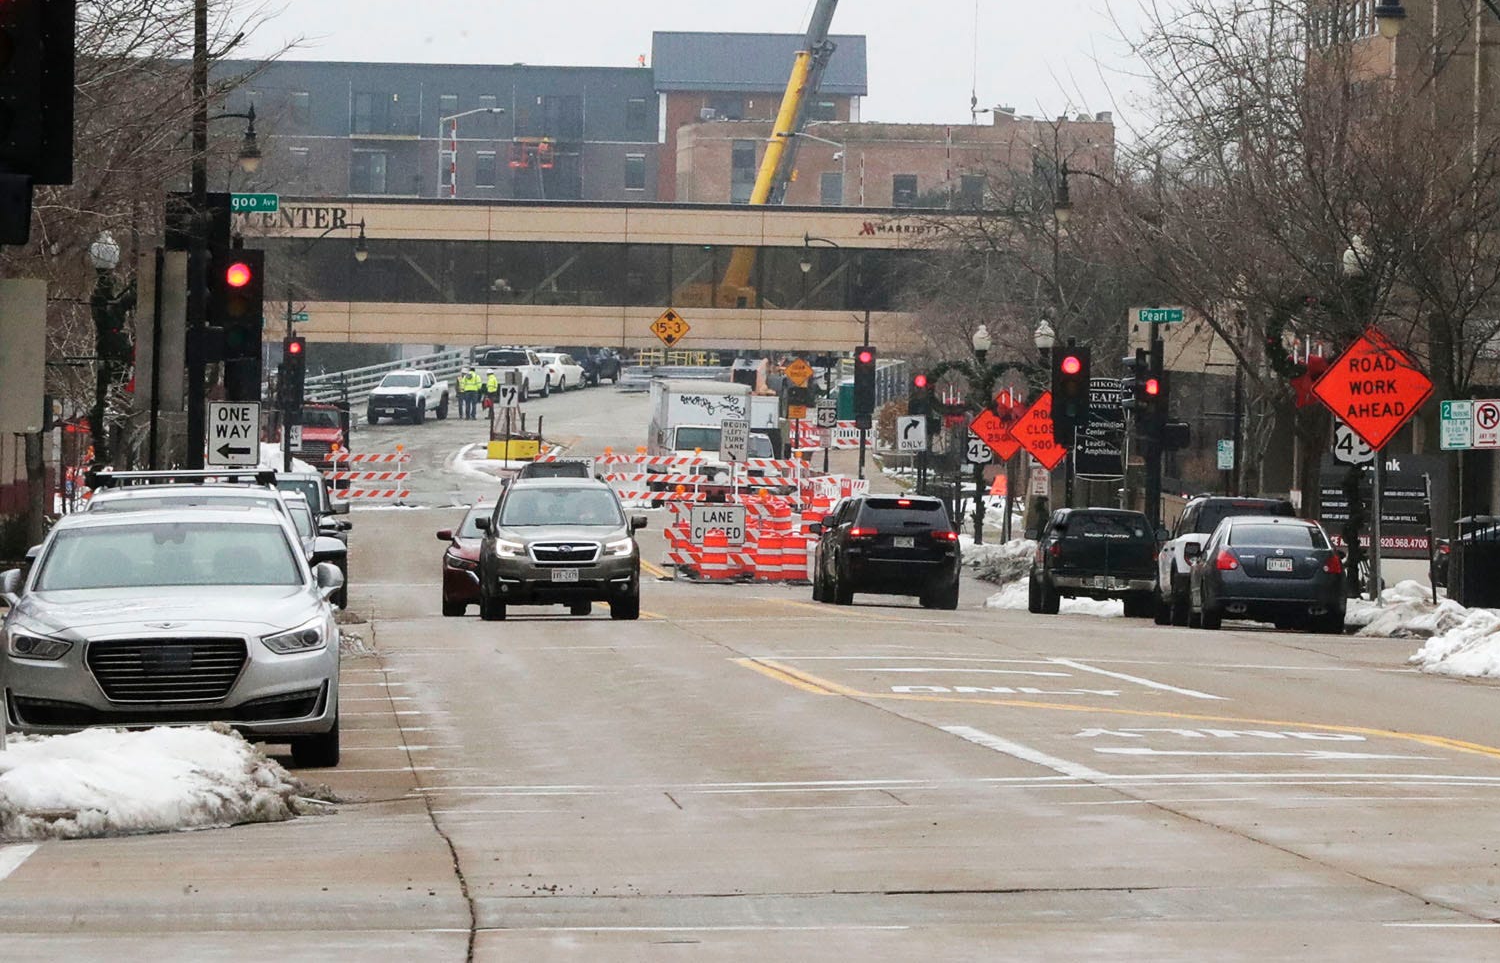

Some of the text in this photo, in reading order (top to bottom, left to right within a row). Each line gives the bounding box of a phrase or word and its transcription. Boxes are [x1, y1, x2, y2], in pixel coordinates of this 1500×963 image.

[877, 224, 941, 235] MARRIOTT
[1142, 311, 1168, 321] Pearl
[1349, 357, 1396, 372] ROAD
[1349, 380, 1397, 395] WORK
[218, 407, 250, 421] ONE
[1033, 409, 1049, 419] RO
[1347, 402, 1405, 418] AHEAD
[1444, 404, 1450, 417] 2
[820, 412, 835, 423] 45
[216, 425, 251, 439] WAY
[1027, 423, 1054, 434] CLOS
[902, 441, 923, 449] ONLY
[969, 444, 991, 457] 45
[703, 512, 734, 523] LANE
[1380, 538, 1428, 549] 920.968.4700
[891, 685, 1122, 696] ONLY
[1072, 728, 1367, 741] ONLY
